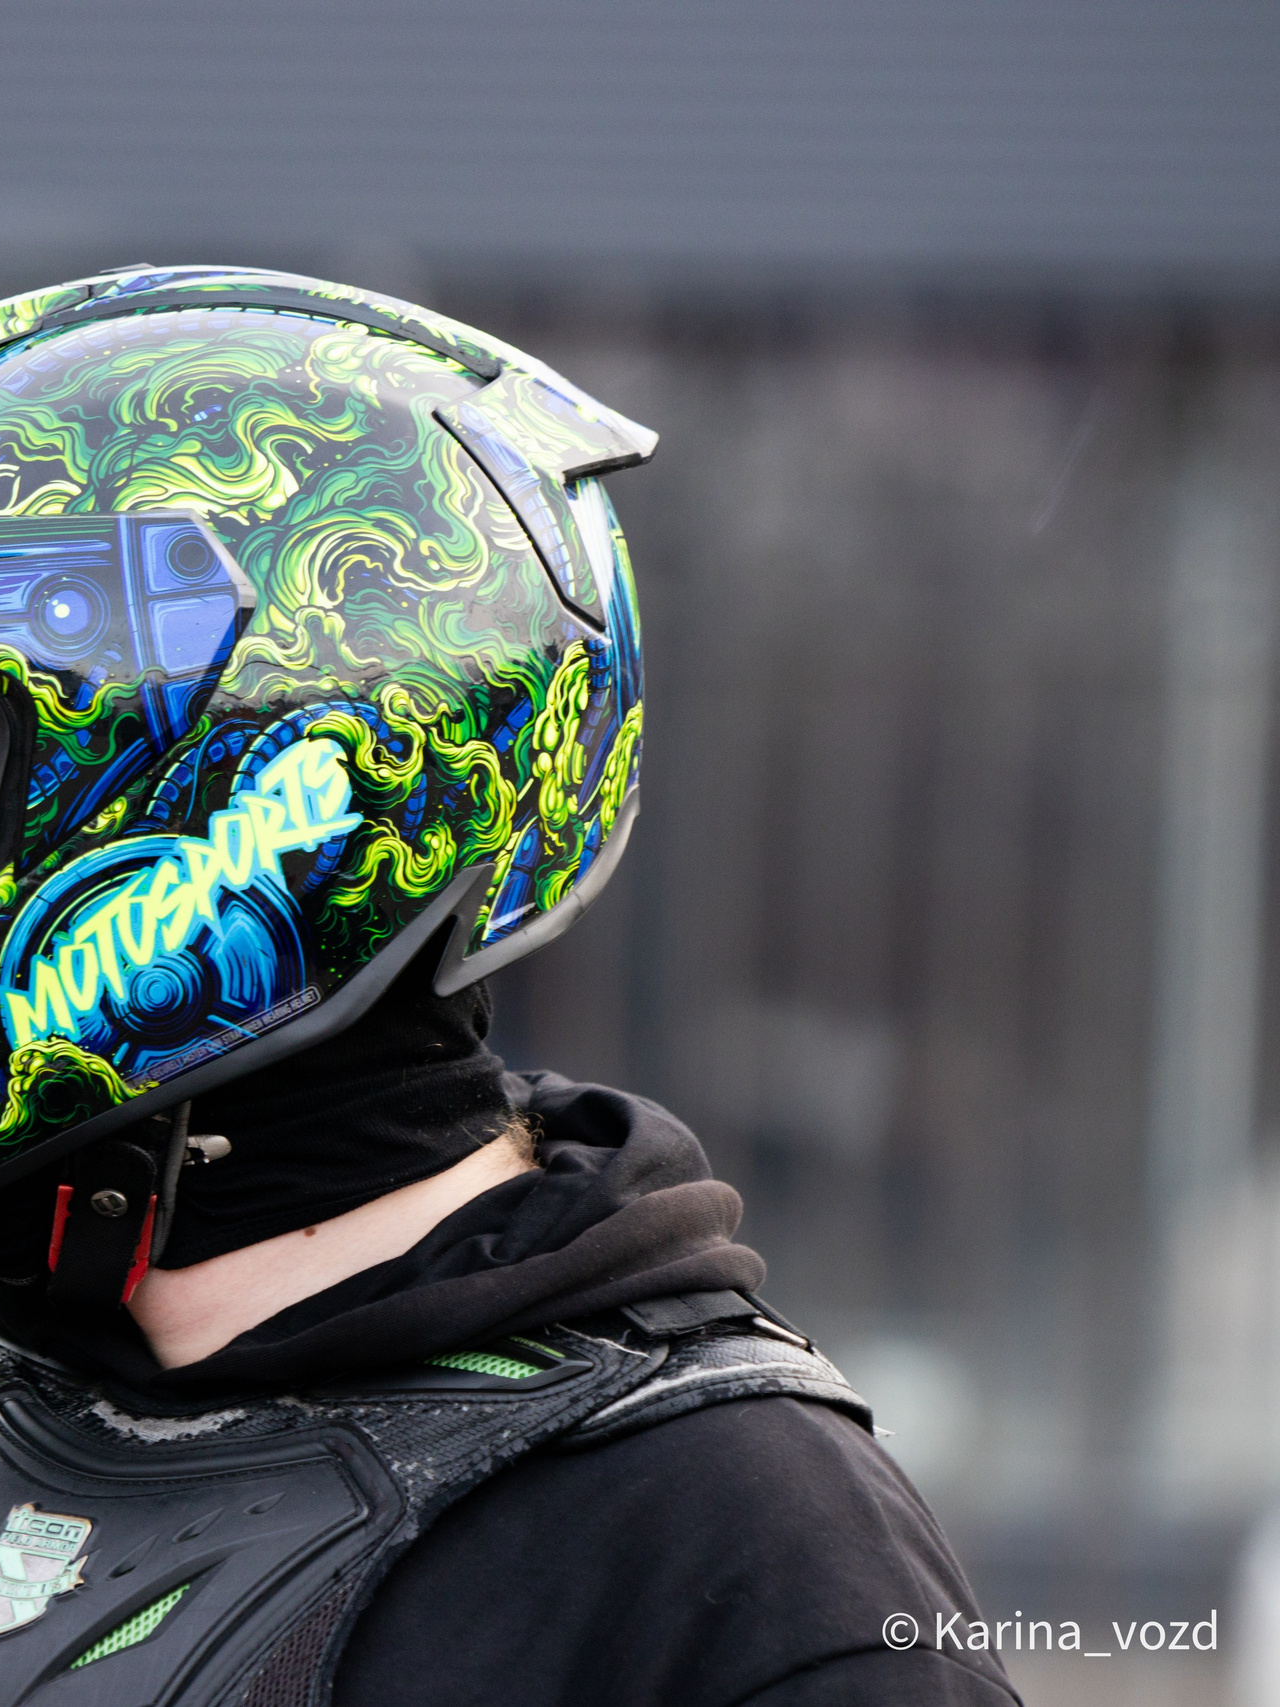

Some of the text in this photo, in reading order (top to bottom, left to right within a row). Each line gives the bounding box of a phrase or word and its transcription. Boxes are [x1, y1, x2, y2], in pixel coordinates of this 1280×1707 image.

[4, 737, 361, 1045] MOTOSPORTS
[1, 1531, 78, 1553] FIELD ARMOR
